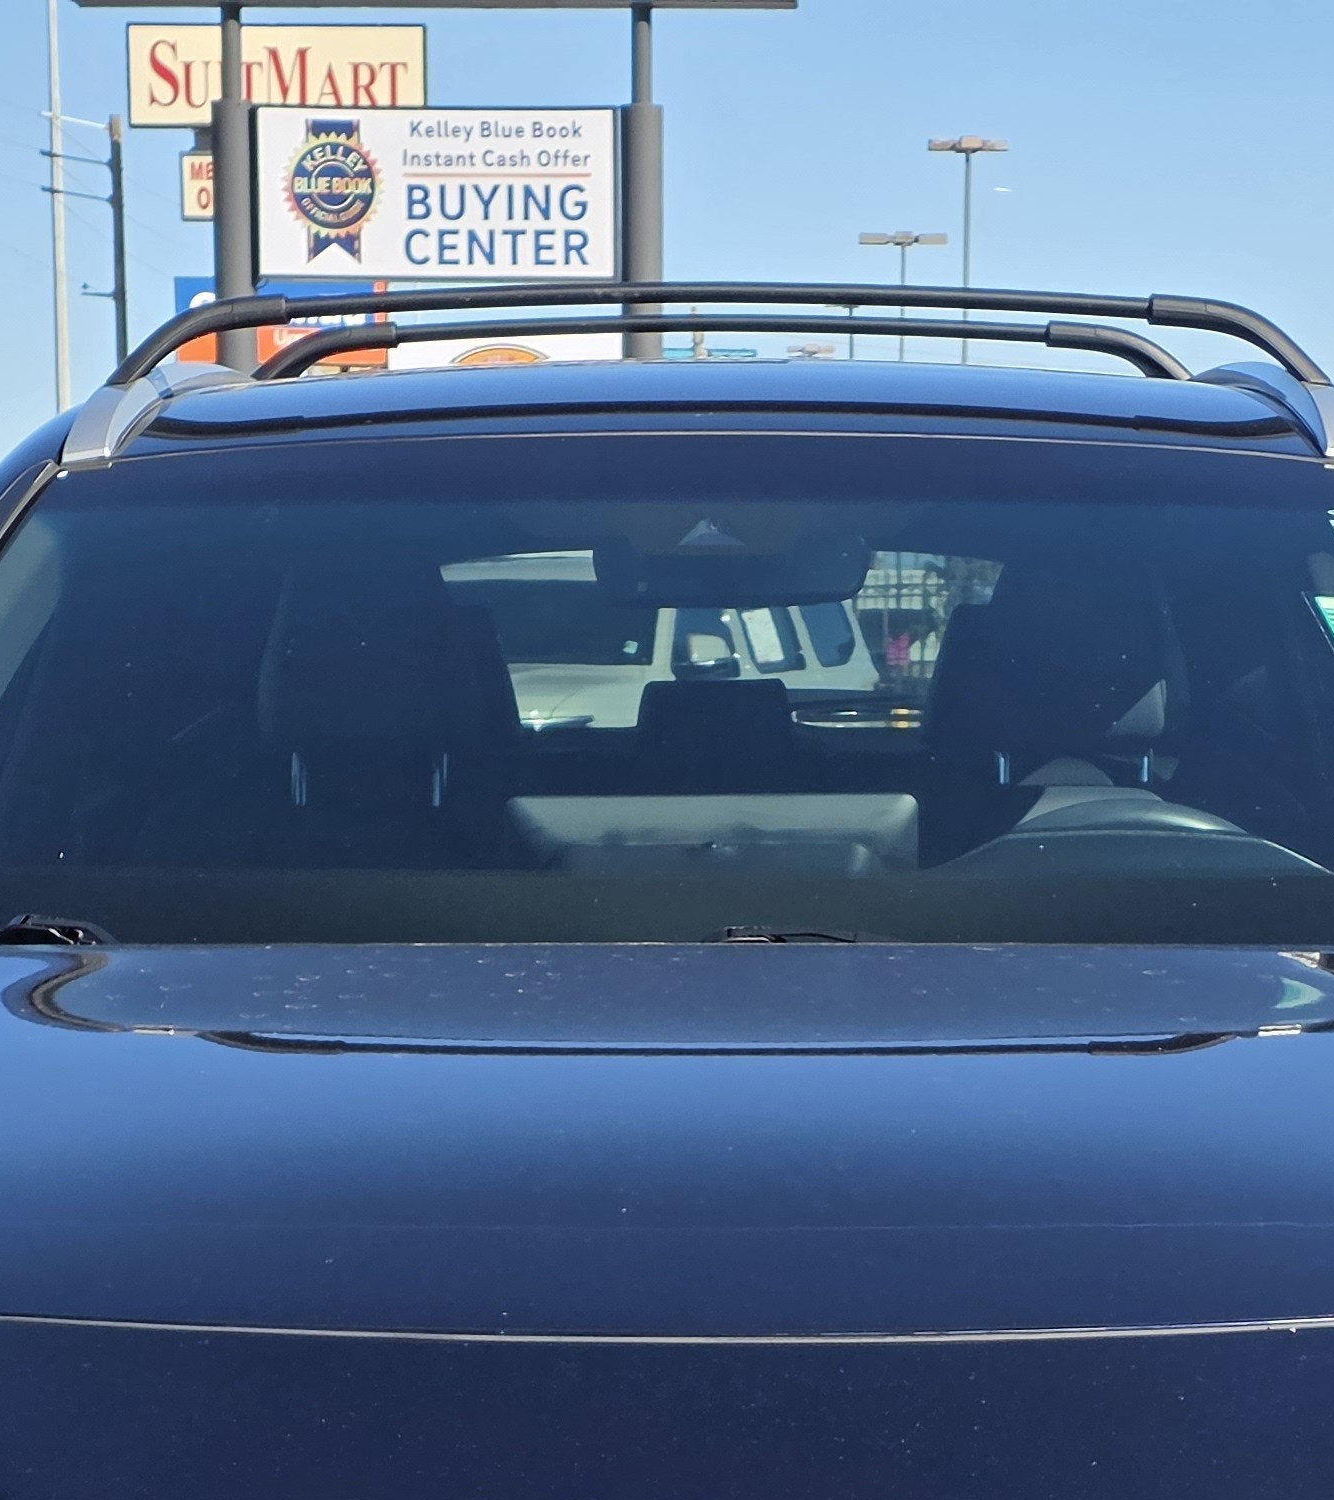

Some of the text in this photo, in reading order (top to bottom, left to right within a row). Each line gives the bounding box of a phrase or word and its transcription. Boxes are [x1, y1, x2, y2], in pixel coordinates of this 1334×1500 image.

[149, 39, 408, 108] SUTMART
[409, 120, 582, 142] Kelley Blue Book
[301, 144, 369, 172] KELLEY
[402, 149, 591, 167] Instant Cash Offer
[293, 176, 372, 195] BLUE BOOK
[406, 183, 588, 220] BUYING
[405, 228, 589, 265] CENTER
